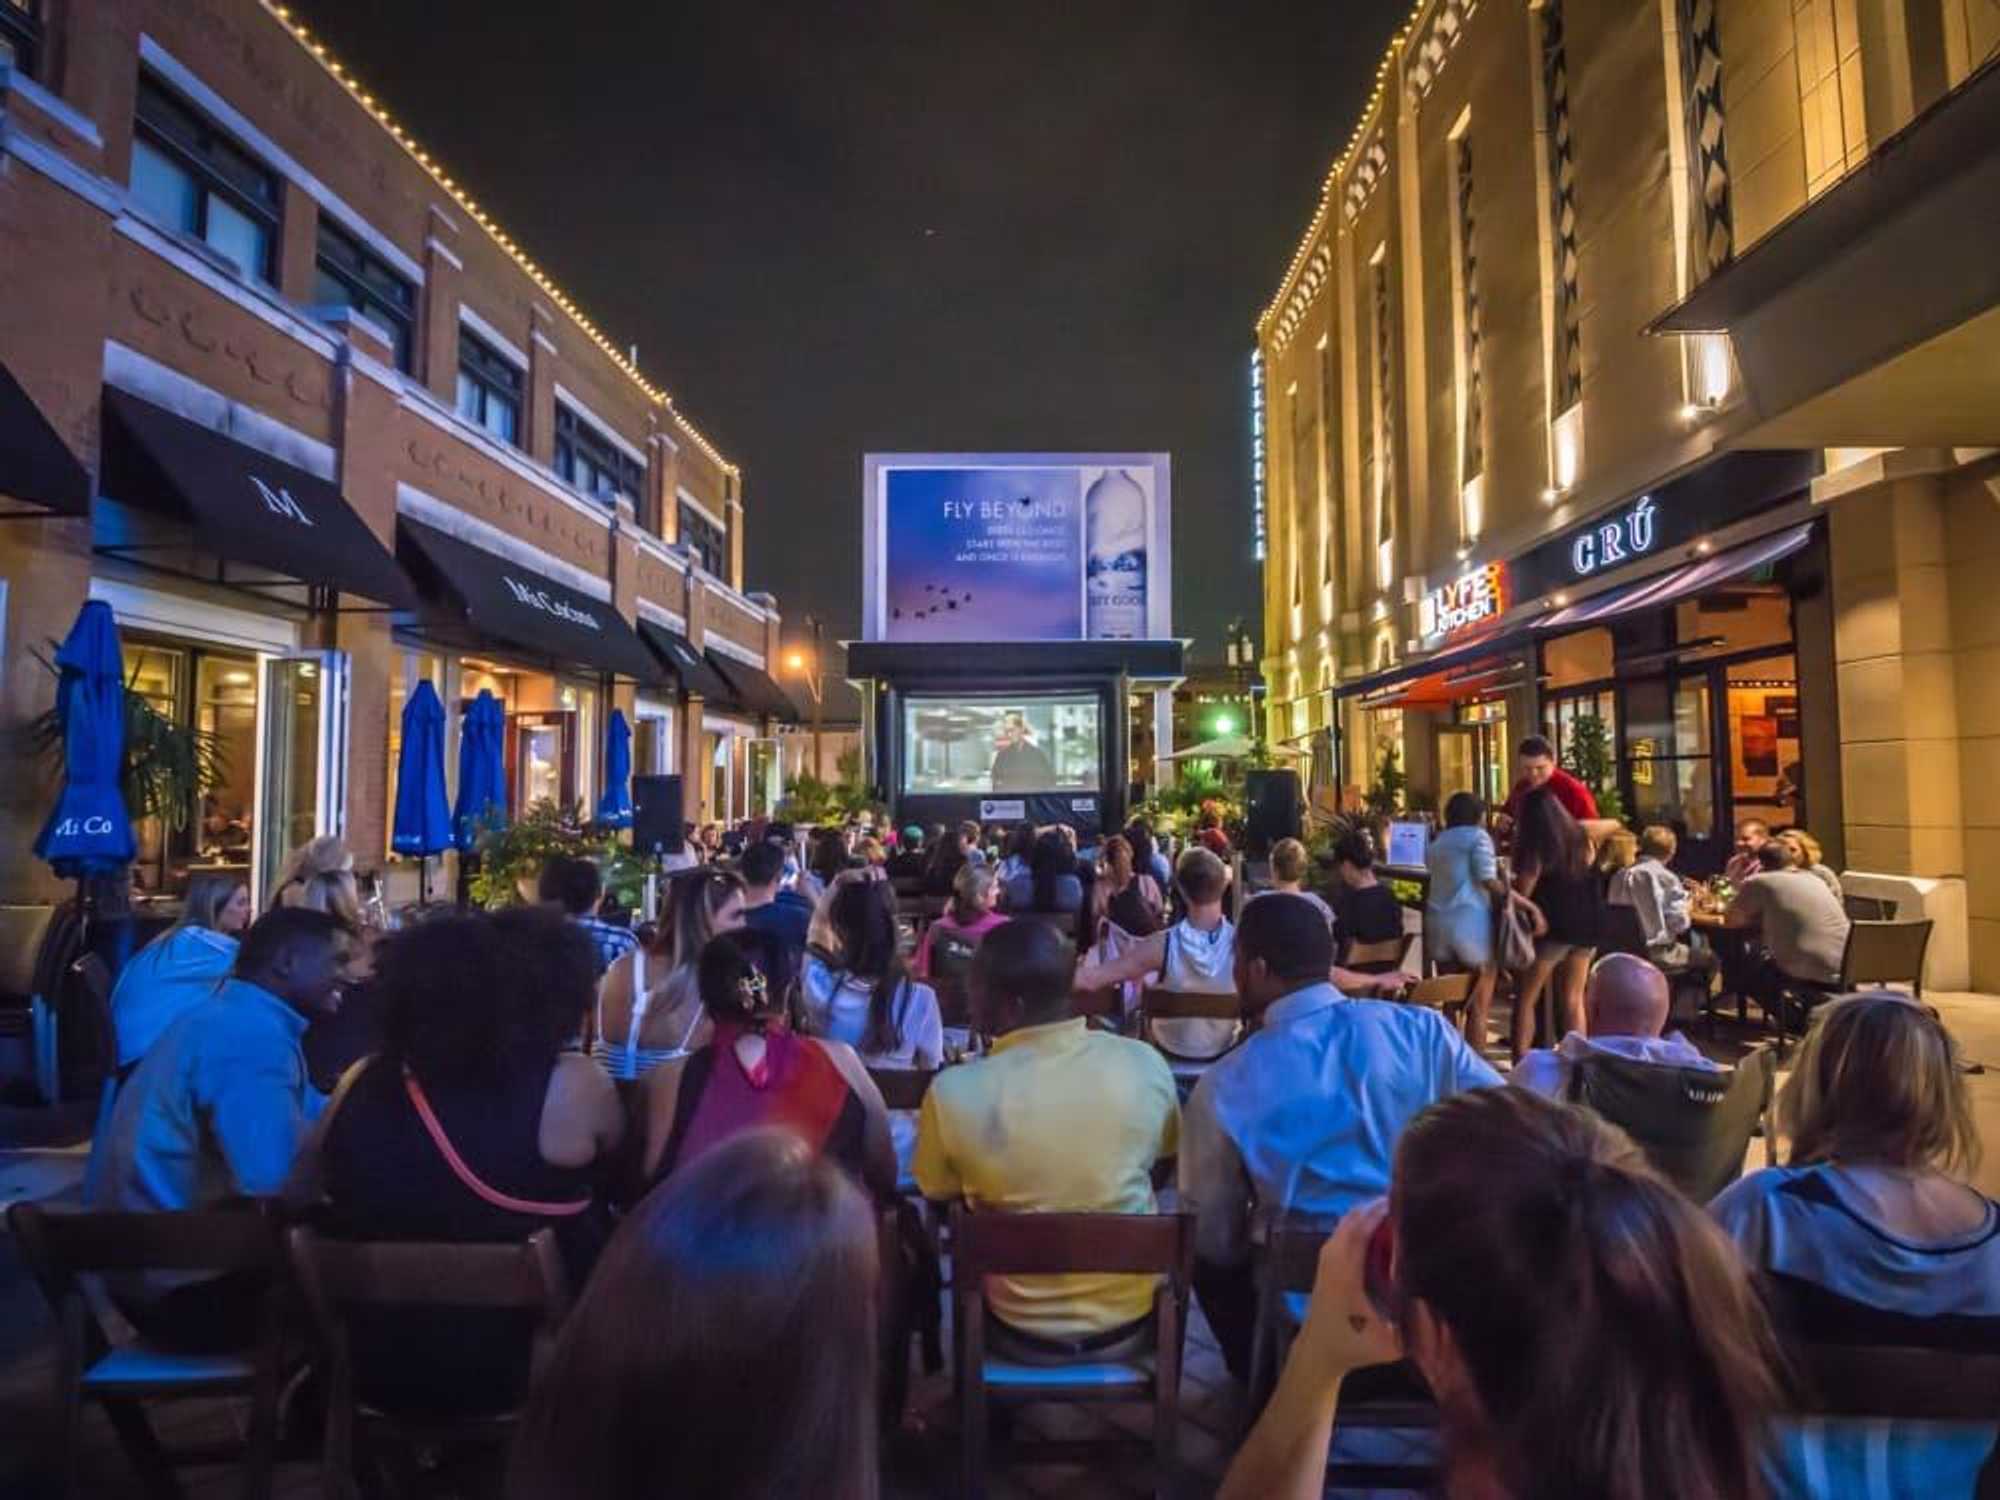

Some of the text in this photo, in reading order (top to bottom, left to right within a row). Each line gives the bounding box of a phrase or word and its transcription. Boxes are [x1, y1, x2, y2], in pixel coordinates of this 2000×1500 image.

[247, 475, 315, 526] M
[944, 500, 1067, 519] FLY BEYOND
[1573, 495, 1656, 575] CRÚ
